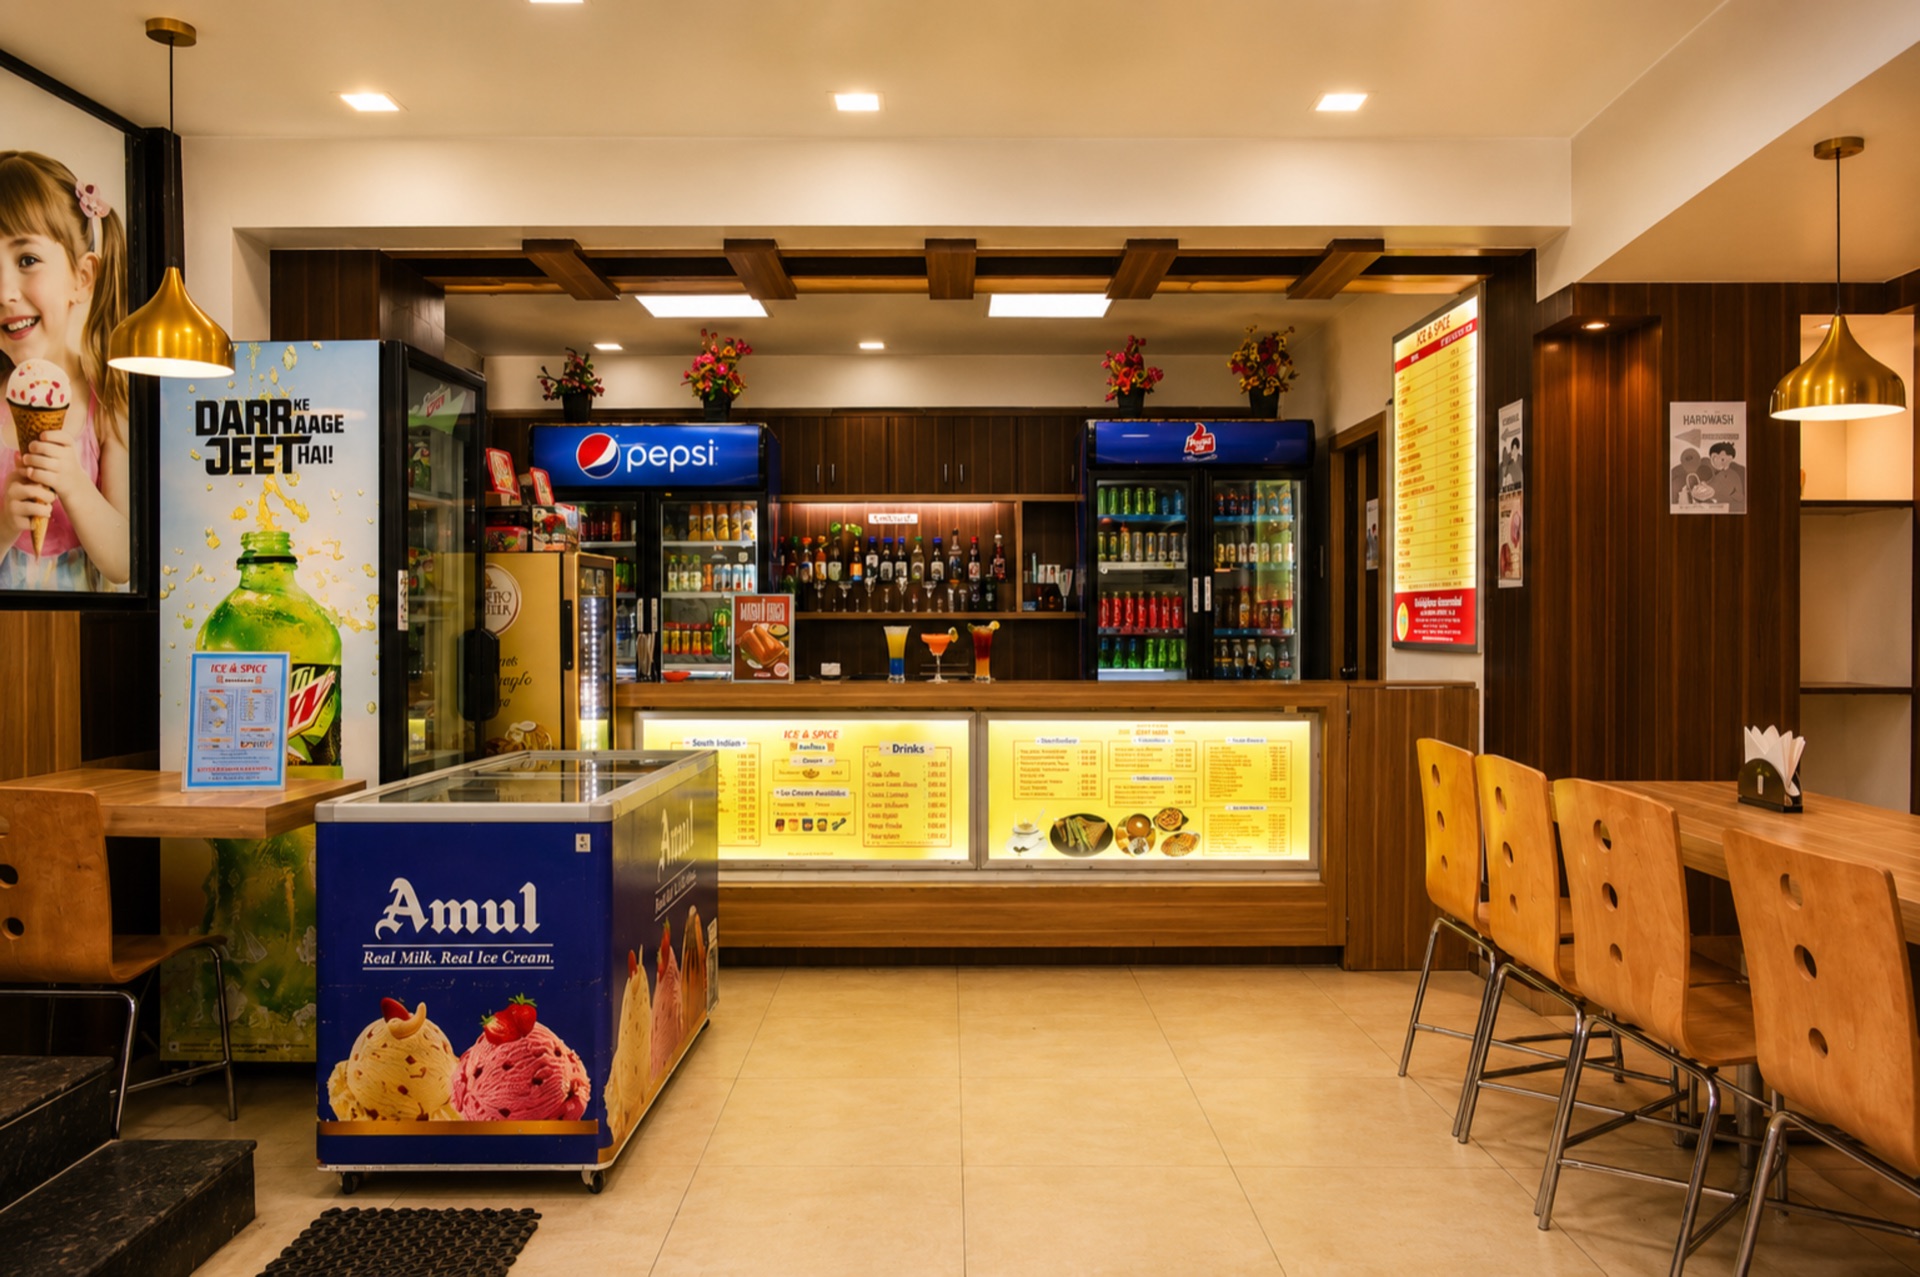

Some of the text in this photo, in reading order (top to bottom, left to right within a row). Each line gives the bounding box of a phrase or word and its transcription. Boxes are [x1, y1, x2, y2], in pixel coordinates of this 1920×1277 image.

[195, 398, 345, 437] DARR KE AAGE
[204, 435, 333, 476] JEET HAI!
[626, 439, 716, 473] pepsi
[783, 729, 800, 740] ICE
[811, 729, 839, 740] SPICE
[892, 744, 925, 754] Drinks
[657, 798, 695, 883] Amul
[374, 876, 541, 940] Amul
[363, 950, 555, 965] Real Milk. Real Ice Cream.
